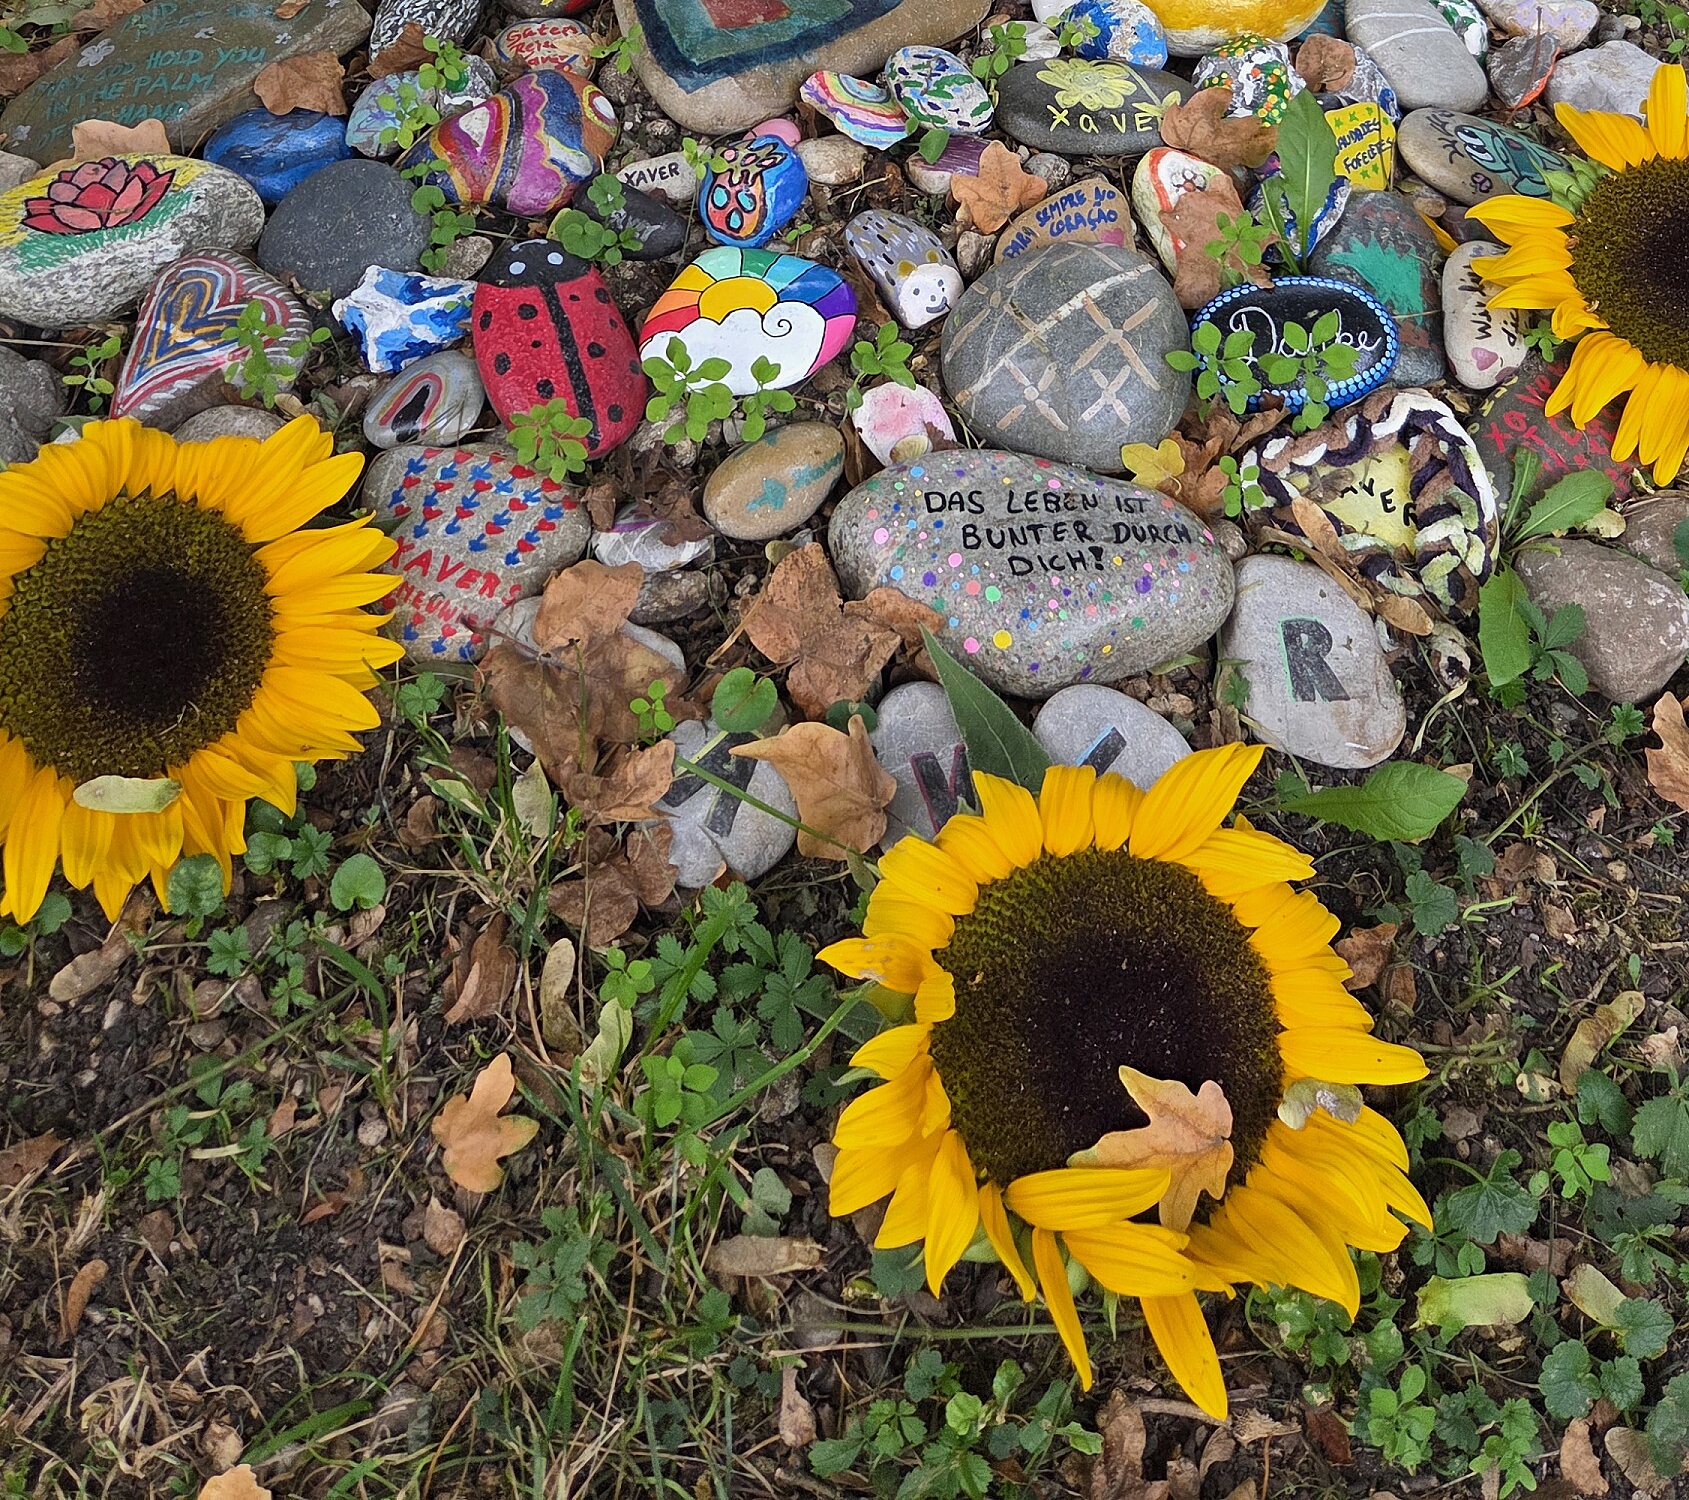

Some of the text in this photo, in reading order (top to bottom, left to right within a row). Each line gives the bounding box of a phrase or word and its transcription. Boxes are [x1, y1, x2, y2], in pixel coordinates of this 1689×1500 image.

[146, 49, 204, 70] HOLD
[214, 46, 265, 71] YOU
[133, 72, 214, 98] PALM
[116, 100, 190, 125] HAND
[624, 162, 679, 187] XAVER
[1002, 186, 1117, 259] PARA SEMPRE NO
[924, 489, 1151, 514] DAS LEBEN IST
[962, 520, 1193, 550] BUNTER DURCH
[1008, 546, 1104, 576] DICH!
[1279, 615, 1351, 703] R
